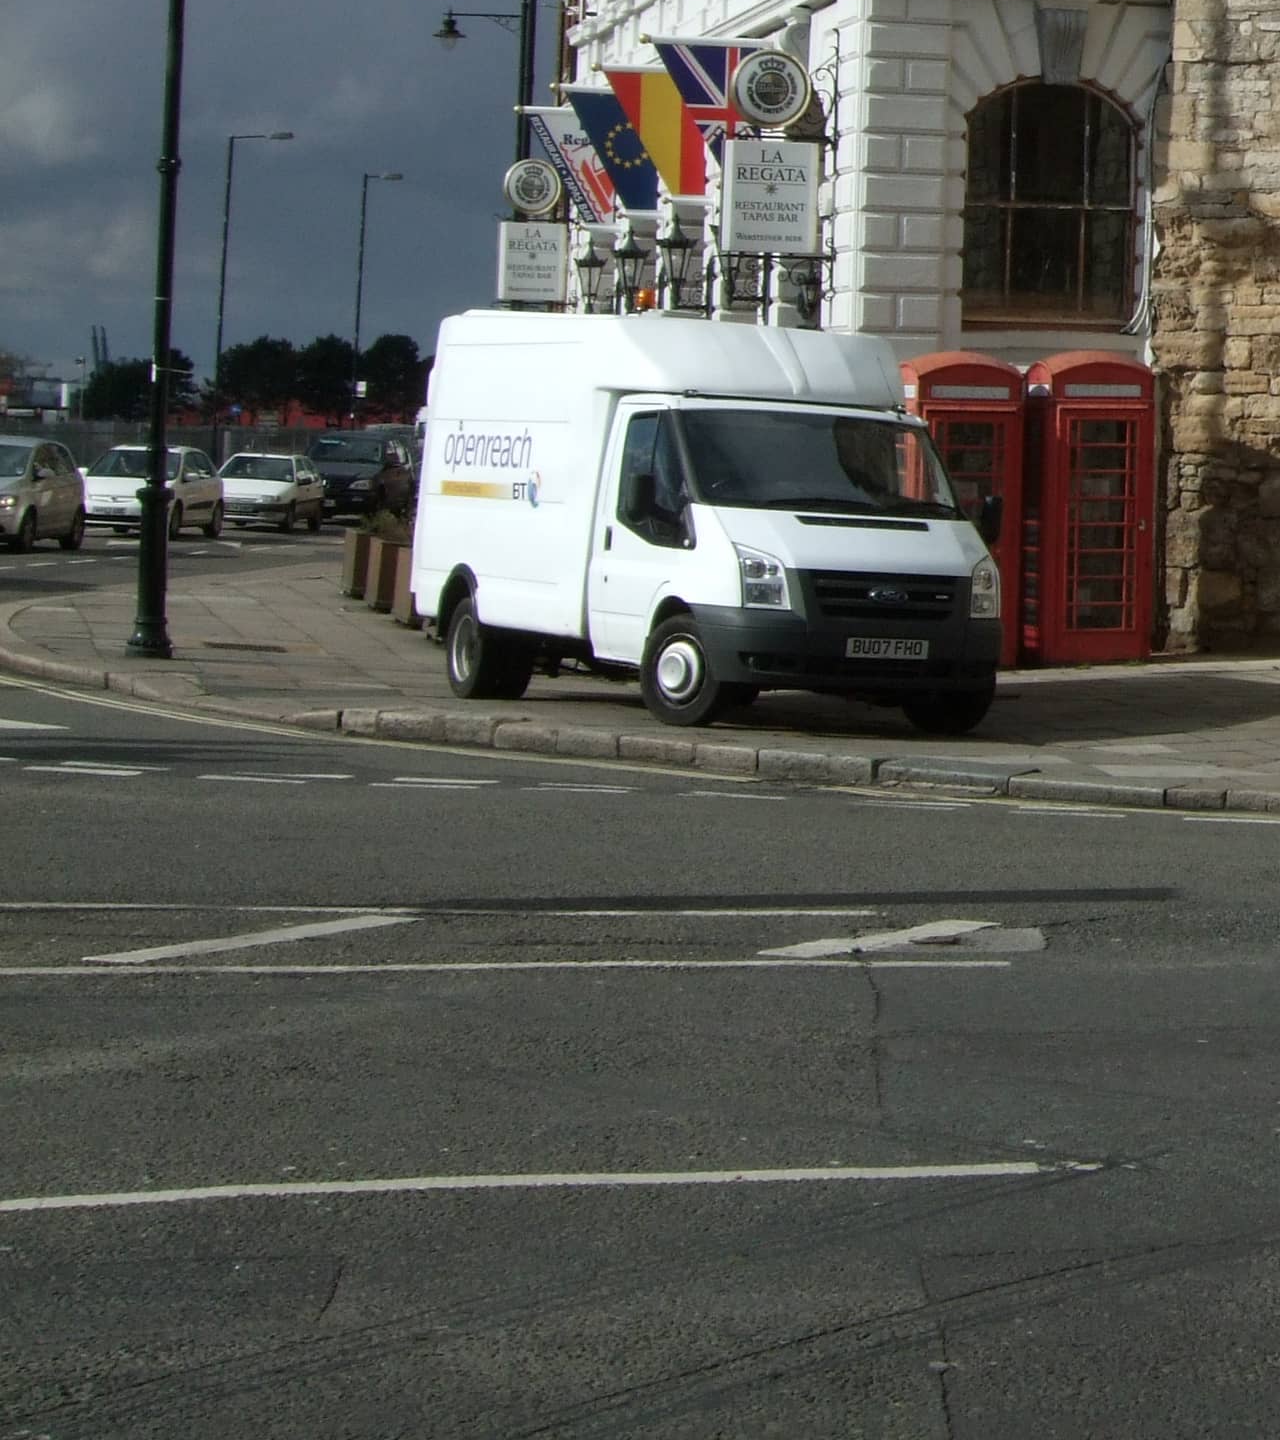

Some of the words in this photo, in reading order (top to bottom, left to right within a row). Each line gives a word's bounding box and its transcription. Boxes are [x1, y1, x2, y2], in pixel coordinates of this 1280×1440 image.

[530, 116, 567, 169] RESTAURANT
[761, 149, 784, 163] LA
[737, 166, 806, 182] REGATA
[735, 201, 805, 212] RESTAURANT
[742, 212, 775, 221] TAPAS
[777, 213, 798, 222] BAR
[525, 228, 542, 238] LA
[508, 240, 557, 251] REGATA
[444, 427, 532, 474] openreach
[513, 482, 527, 500] BT
[852, 639, 891, 655] BU07
